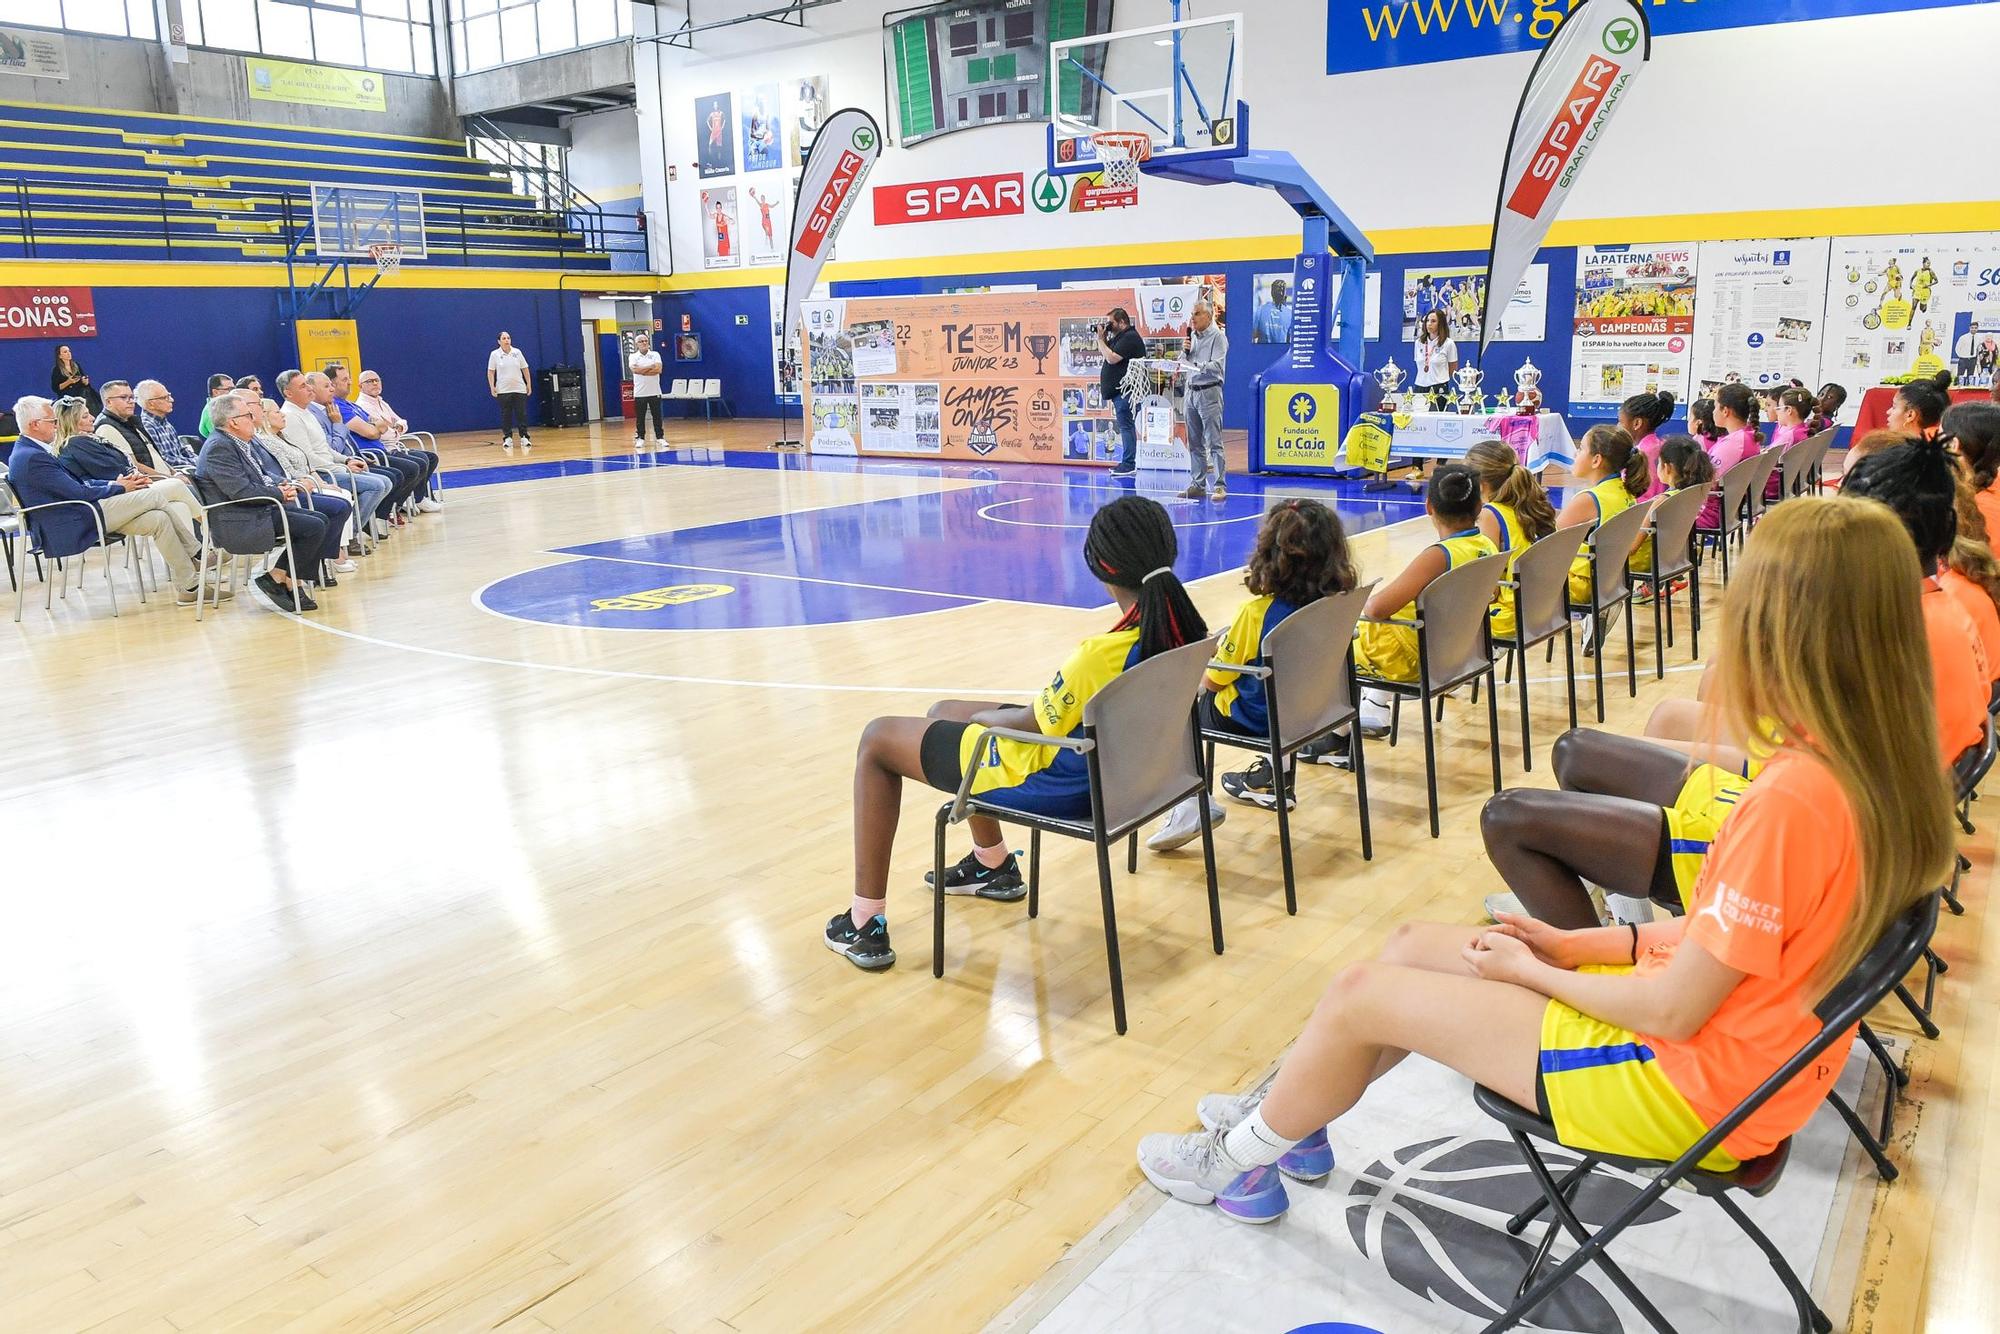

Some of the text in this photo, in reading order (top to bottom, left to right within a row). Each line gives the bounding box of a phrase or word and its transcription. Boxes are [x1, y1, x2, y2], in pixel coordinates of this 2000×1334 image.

[955, 10, 970, 18] LOCAL
[1533, 60, 1614, 181] SPAR
[1559, 73, 1631, 189] GRAN CANARIA
[810, 153, 860, 234] SPAR
[827, 163, 869, 239] GRAN CANARIA
[906, 179, 1021, 217] SPAR
[1585, 252, 1689, 265] LA PATERNA NEWS
[896, 325, 911, 339] 22
[1600, 322, 1667, 334] CAMPEONAS
[944, 386, 1019, 413] CAMPE
[1032, 401, 1050, 410] 50
[1283, 427, 1319, 435] Fundación
[1278, 437, 1325, 450] La Caja
[1288, 450, 1325, 458] CANARIAS
[1727, 887, 1781, 919] BASKET
[1722, 902, 1783, 935] COUNTRY
